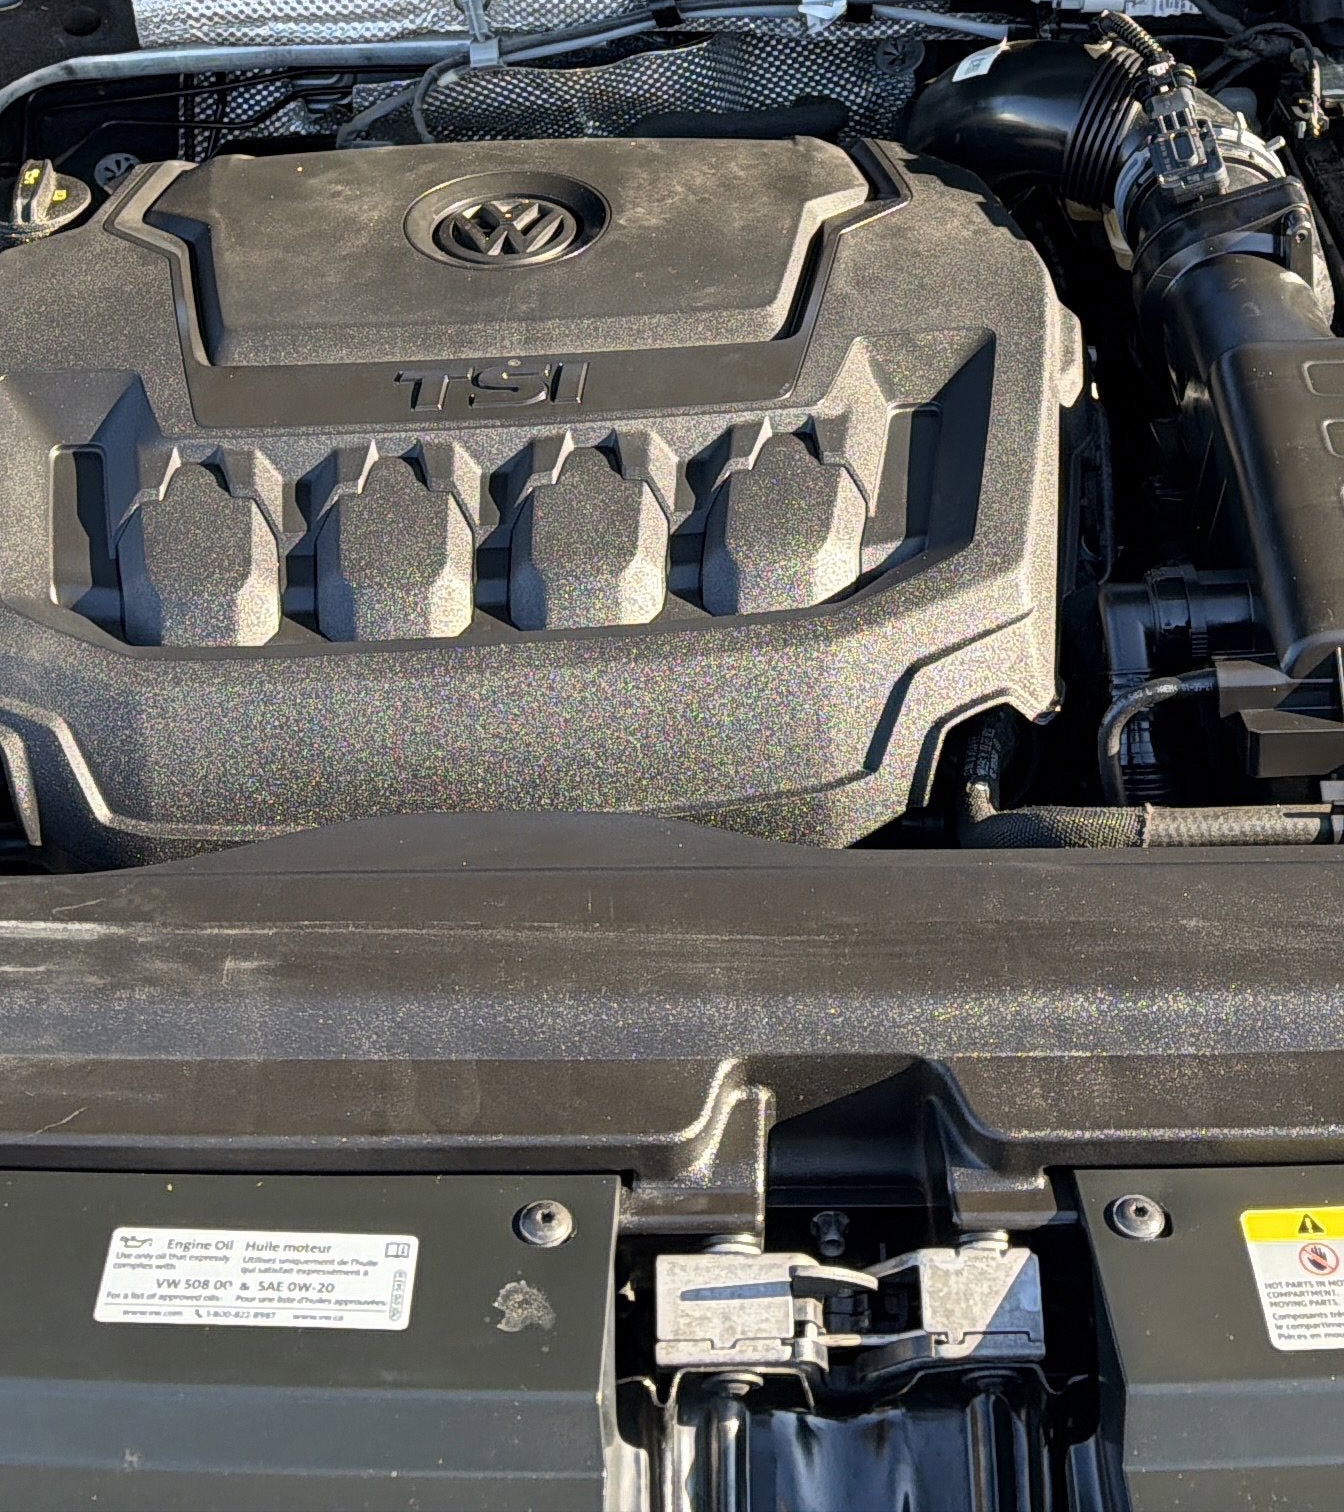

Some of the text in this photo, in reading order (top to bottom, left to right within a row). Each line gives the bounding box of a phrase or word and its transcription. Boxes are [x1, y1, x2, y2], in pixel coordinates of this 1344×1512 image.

[394, 361, 591, 412] TSI
[167, 1238, 234, 1252] Engine Oil
[245, 1240, 332, 1254] Huile moteur
[116, 1251, 132, 1259] Use
[134, 1252, 153, 1261] only
[168, 1253, 187, 1261] that
[189, 1255, 230, 1263] expressly
[113, 1262, 153, 1270] complies
[156, 1278, 335, 1293] VW 508 00 & SAE 0W-20
[1265, 1281, 1283, 1289] HOT
[1285, 1281, 1314, 1289] PARTS
[1316, 1280, 1326, 1288] IN
[106, 1291, 121, 1299] For
[131, 1292, 145, 1300] list
[158, 1294, 201, 1302] approved
[235, 1294, 256, 1303] Pour
[277, 1296, 296, 1304] liste
[1269, 1300, 1307, 1308] MOVING
[1272, 1311, 1328, 1321] Composants
